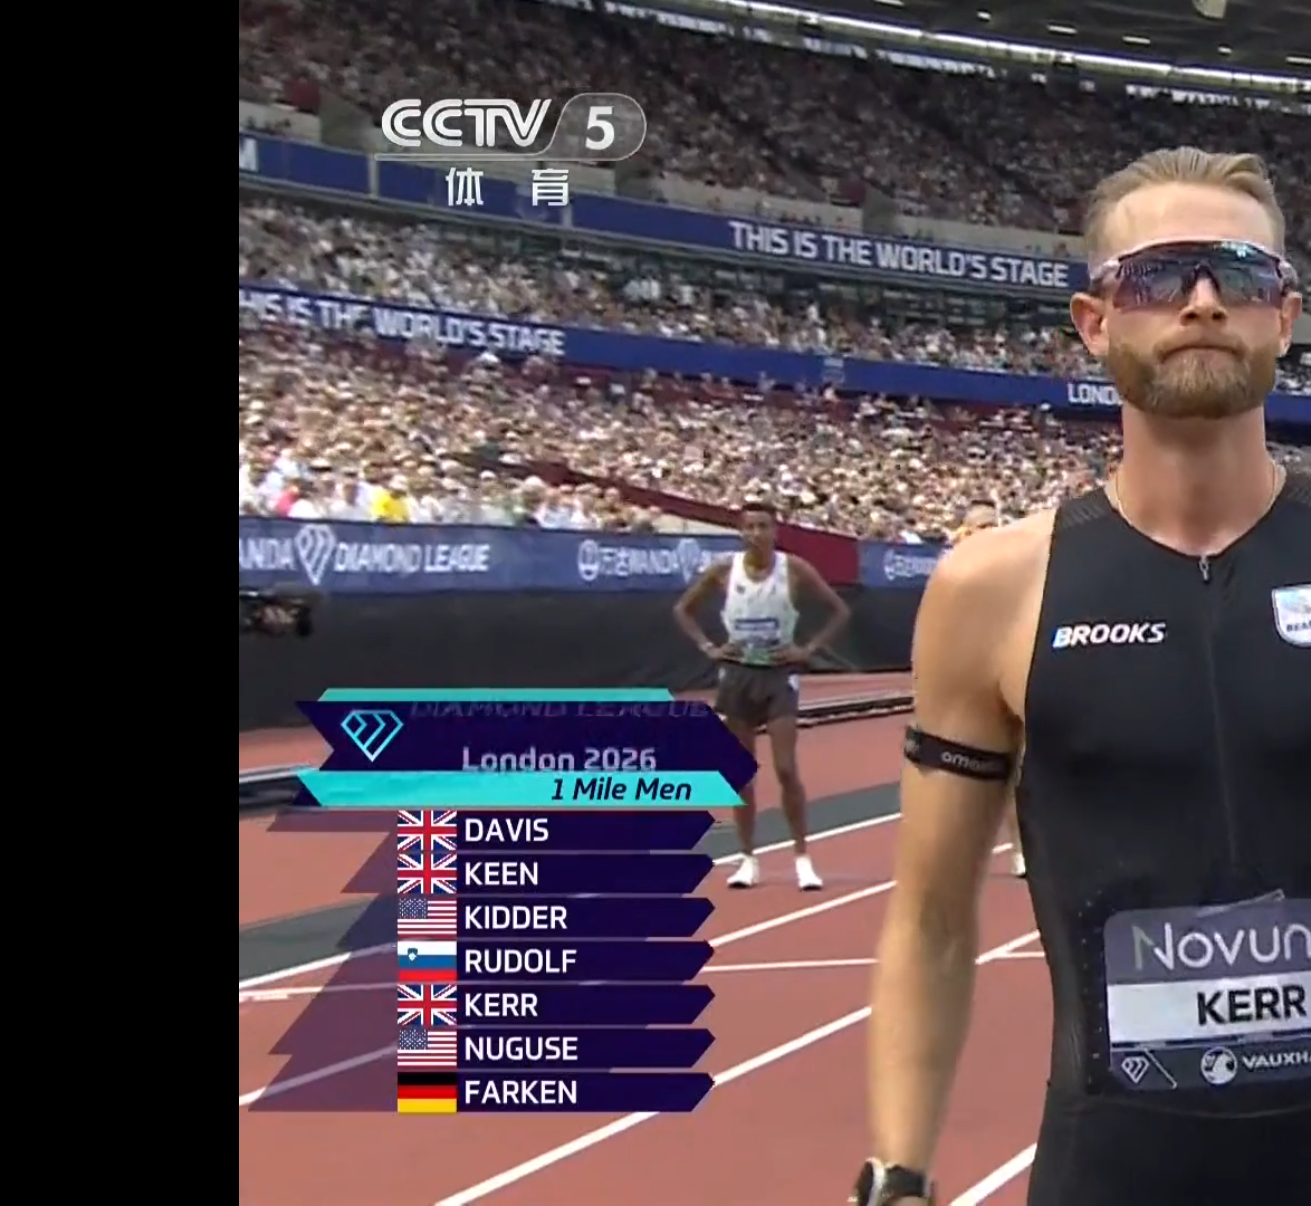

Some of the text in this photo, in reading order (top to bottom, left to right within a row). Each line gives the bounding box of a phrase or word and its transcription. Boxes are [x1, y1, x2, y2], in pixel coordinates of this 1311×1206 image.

[729, 220, 1070, 288] THIS IS THE WORLD'S STAGE
[239, 288, 282, 322] HIS
[487, 322, 567, 357] STAGE
[1066, 381, 1119, 405] LOND
[334, 542, 422, 573] DIAMOND
[423, 544, 490, 573] LEAGUE
[1052, 622, 1167, 648] BROOKS
[1196, 983, 1308, 1027] KERR
